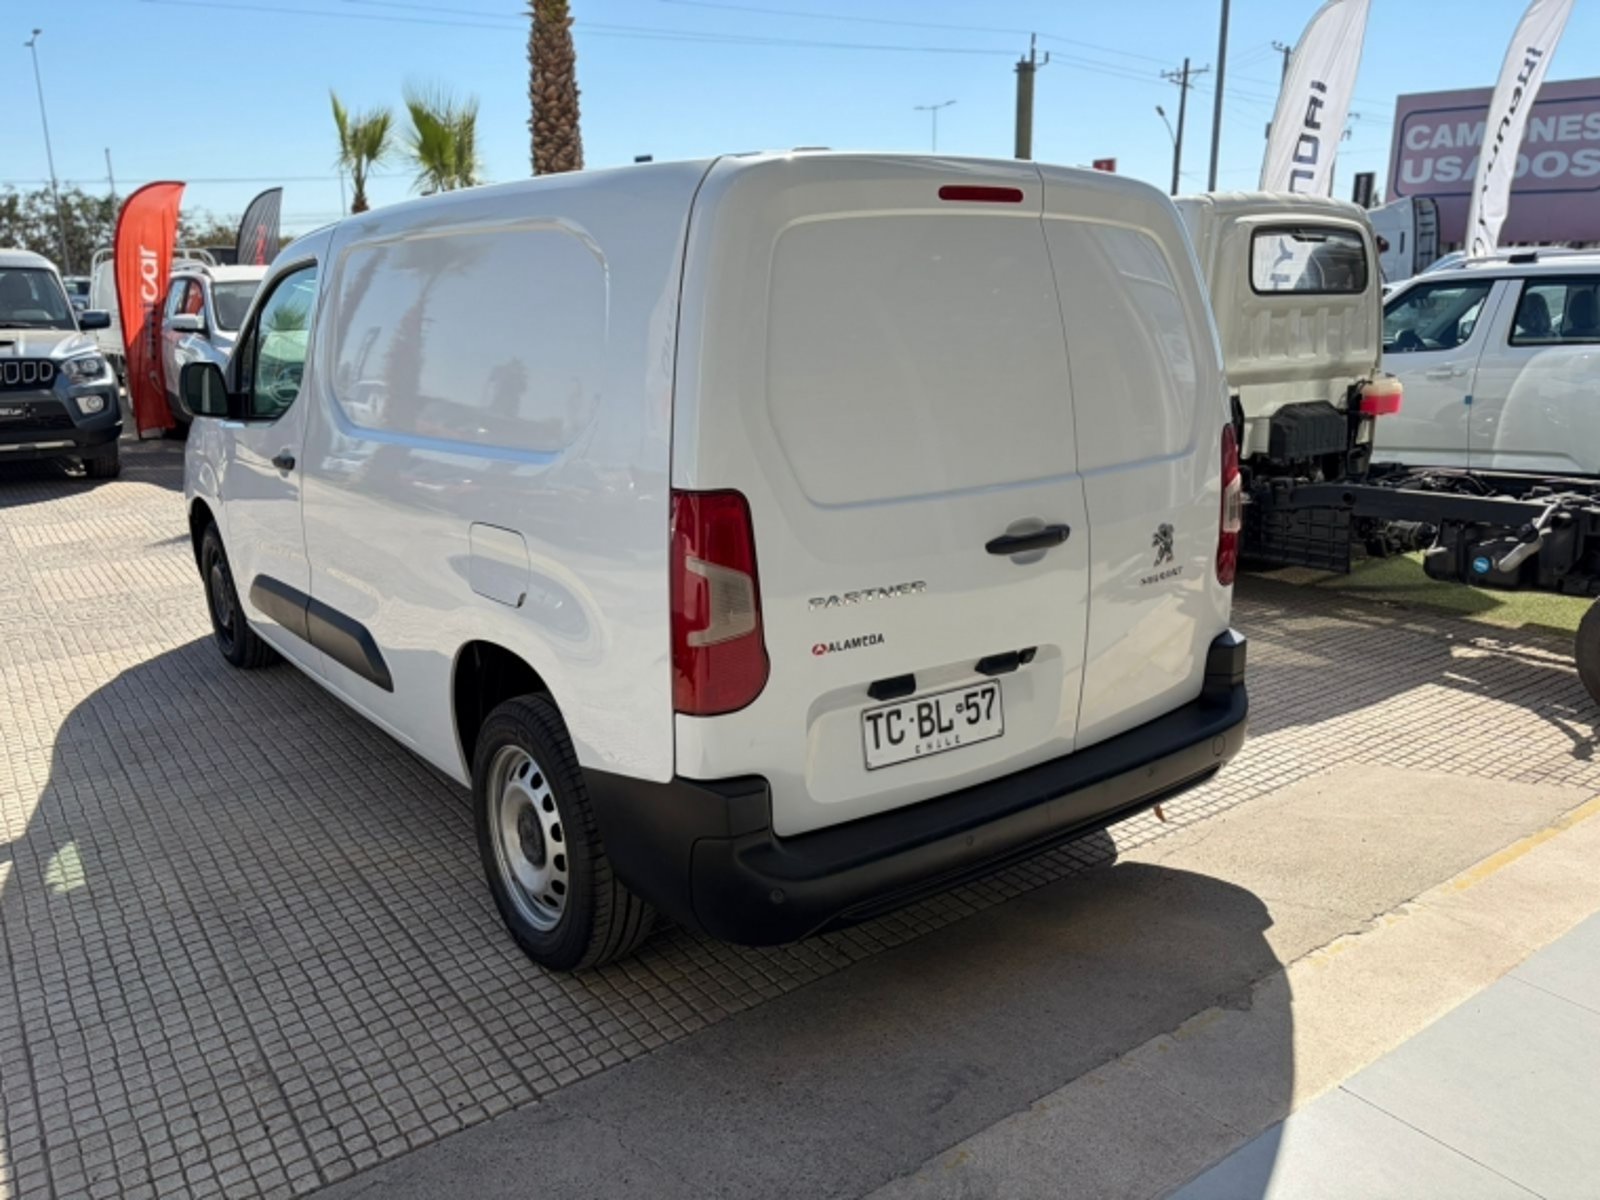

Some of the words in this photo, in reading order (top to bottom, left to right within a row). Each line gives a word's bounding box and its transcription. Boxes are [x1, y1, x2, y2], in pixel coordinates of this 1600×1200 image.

[1404, 111, 1600, 150] CAMNES
[807, 580, 928, 612] PARTNER
[827, 633, 886, 654] ALAMEDA
